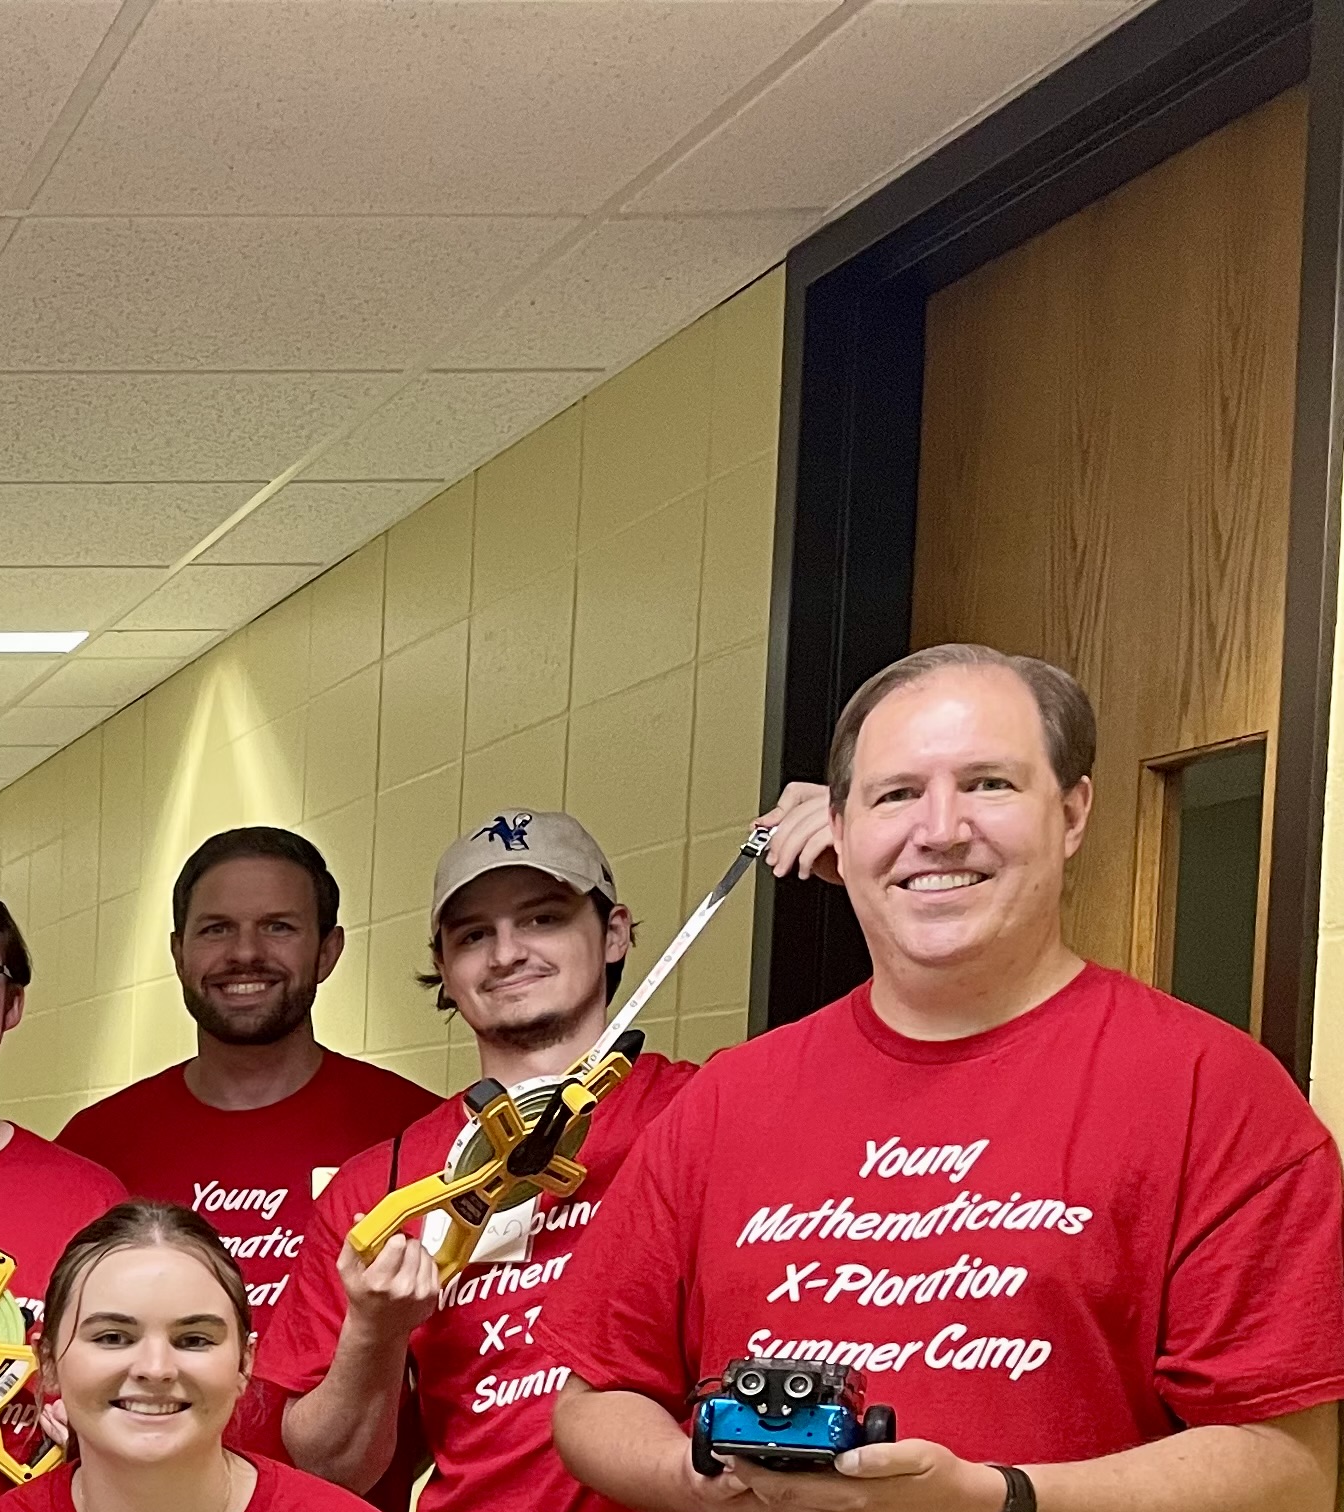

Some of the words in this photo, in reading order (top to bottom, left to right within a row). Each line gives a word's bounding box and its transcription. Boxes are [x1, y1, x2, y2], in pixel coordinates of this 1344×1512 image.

[859, 1136, 990, 1183] Young
[191, 1180, 289, 1220] Young
[736, 1190, 1093, 1248] Mathematicians
[766, 1253, 1028, 1306] X-Ploration
[745, 1328, 924, 1372] Summer
[924, 1323, 1052, 1381] Camp
